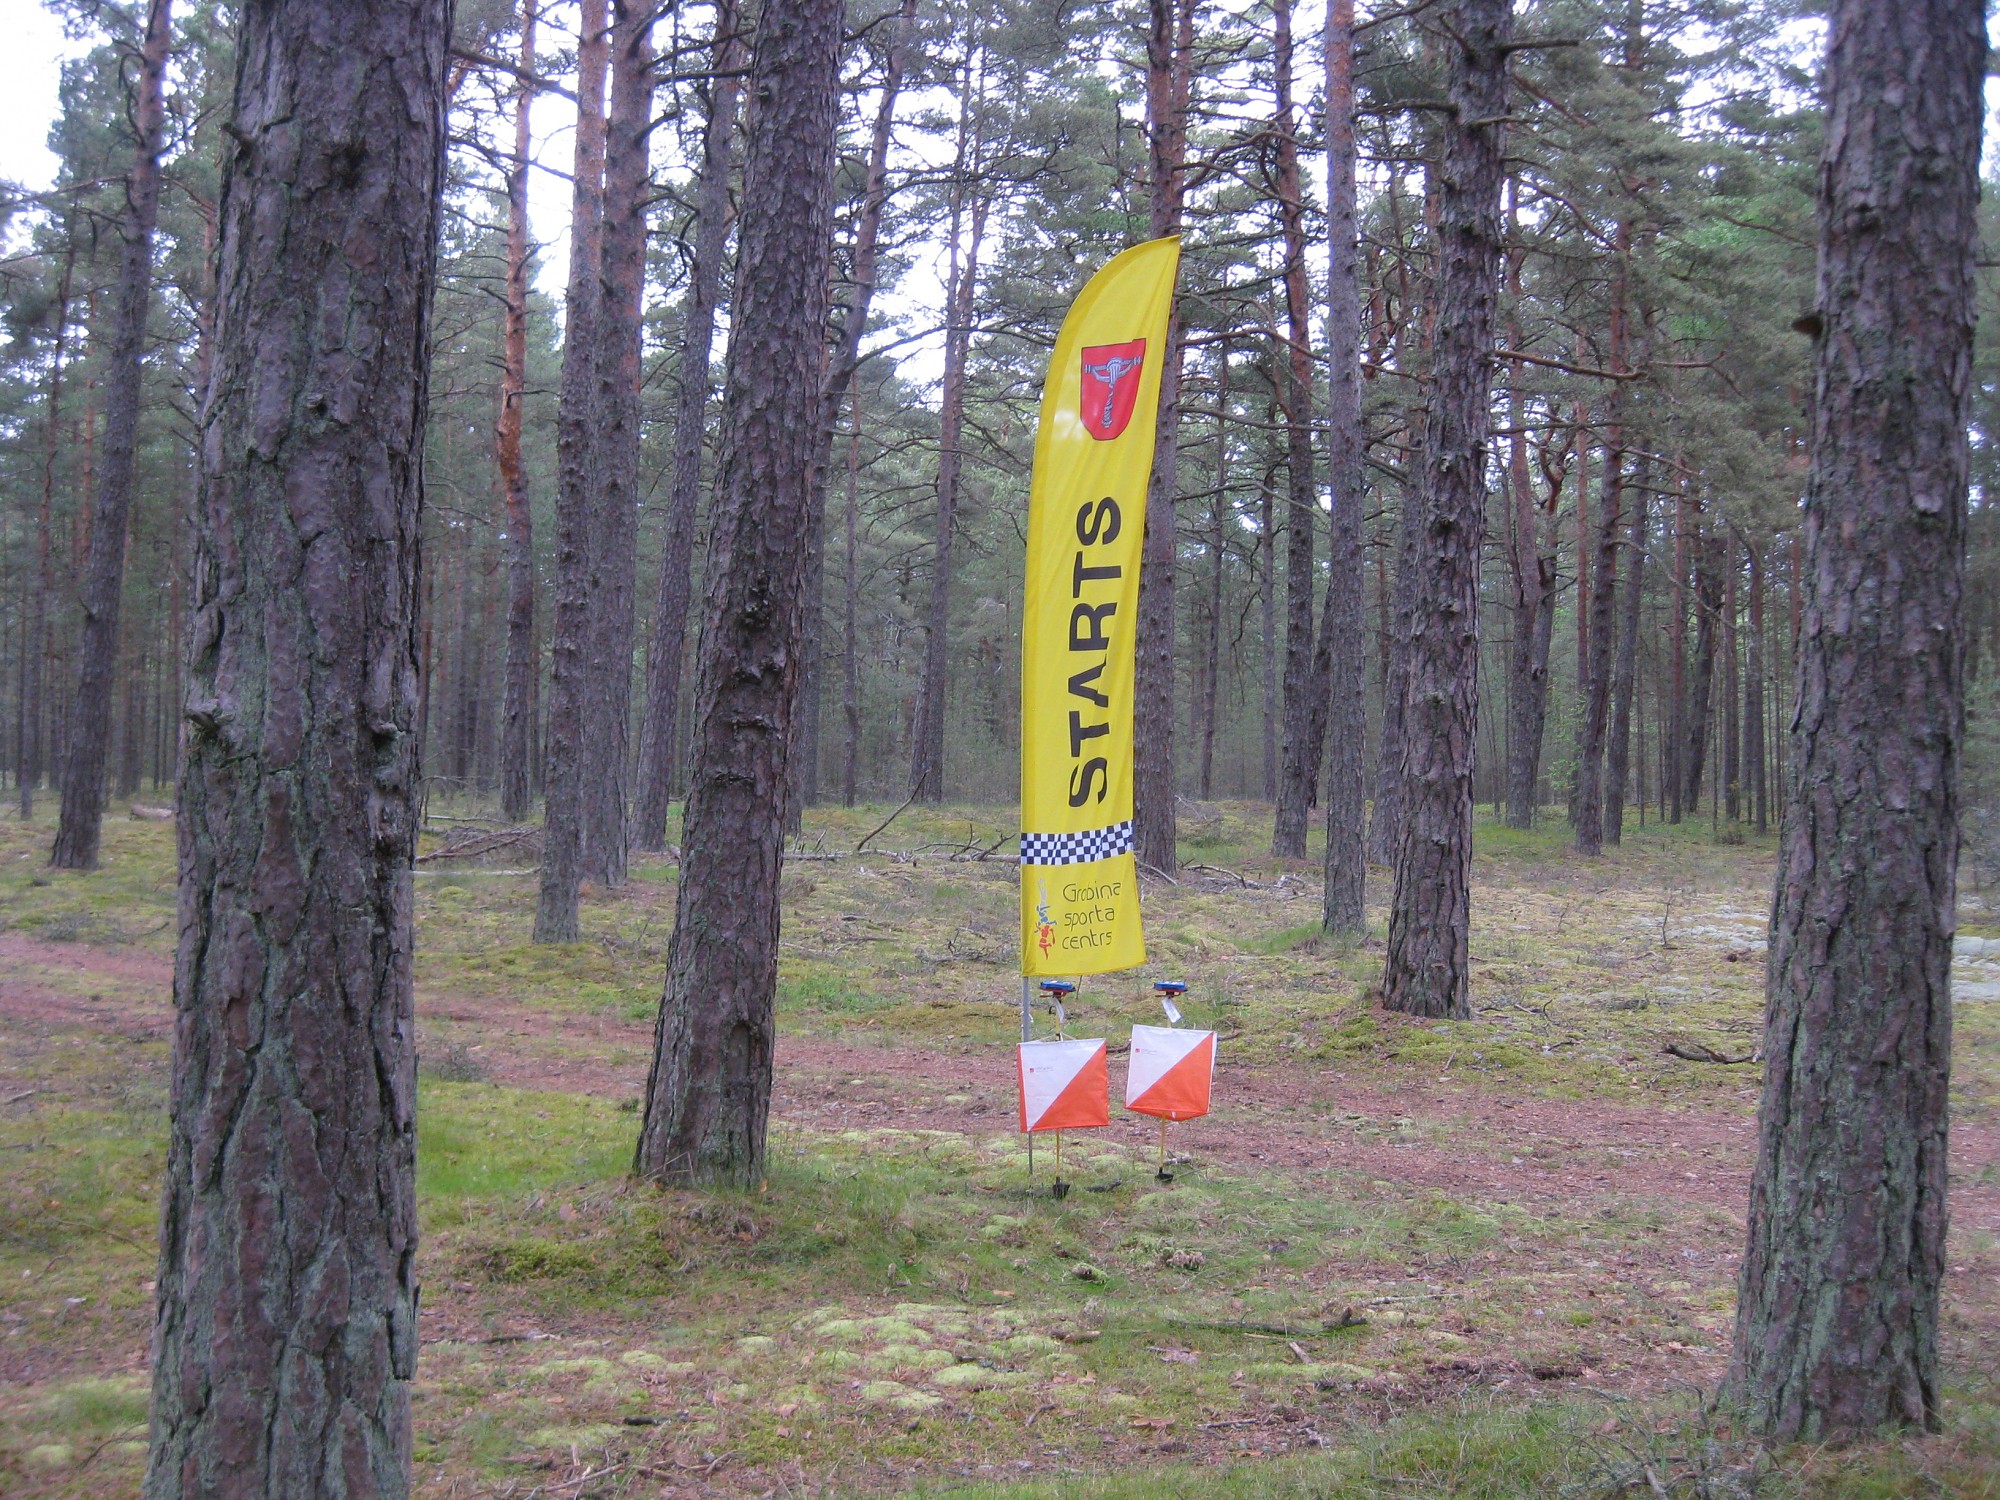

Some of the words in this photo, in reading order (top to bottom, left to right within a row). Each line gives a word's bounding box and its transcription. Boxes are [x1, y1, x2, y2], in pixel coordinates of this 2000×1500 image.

[1068, 496, 1122, 807] STARTS
[1064, 905, 1115, 931] sporta
[1062, 930, 1113, 950] centrs
